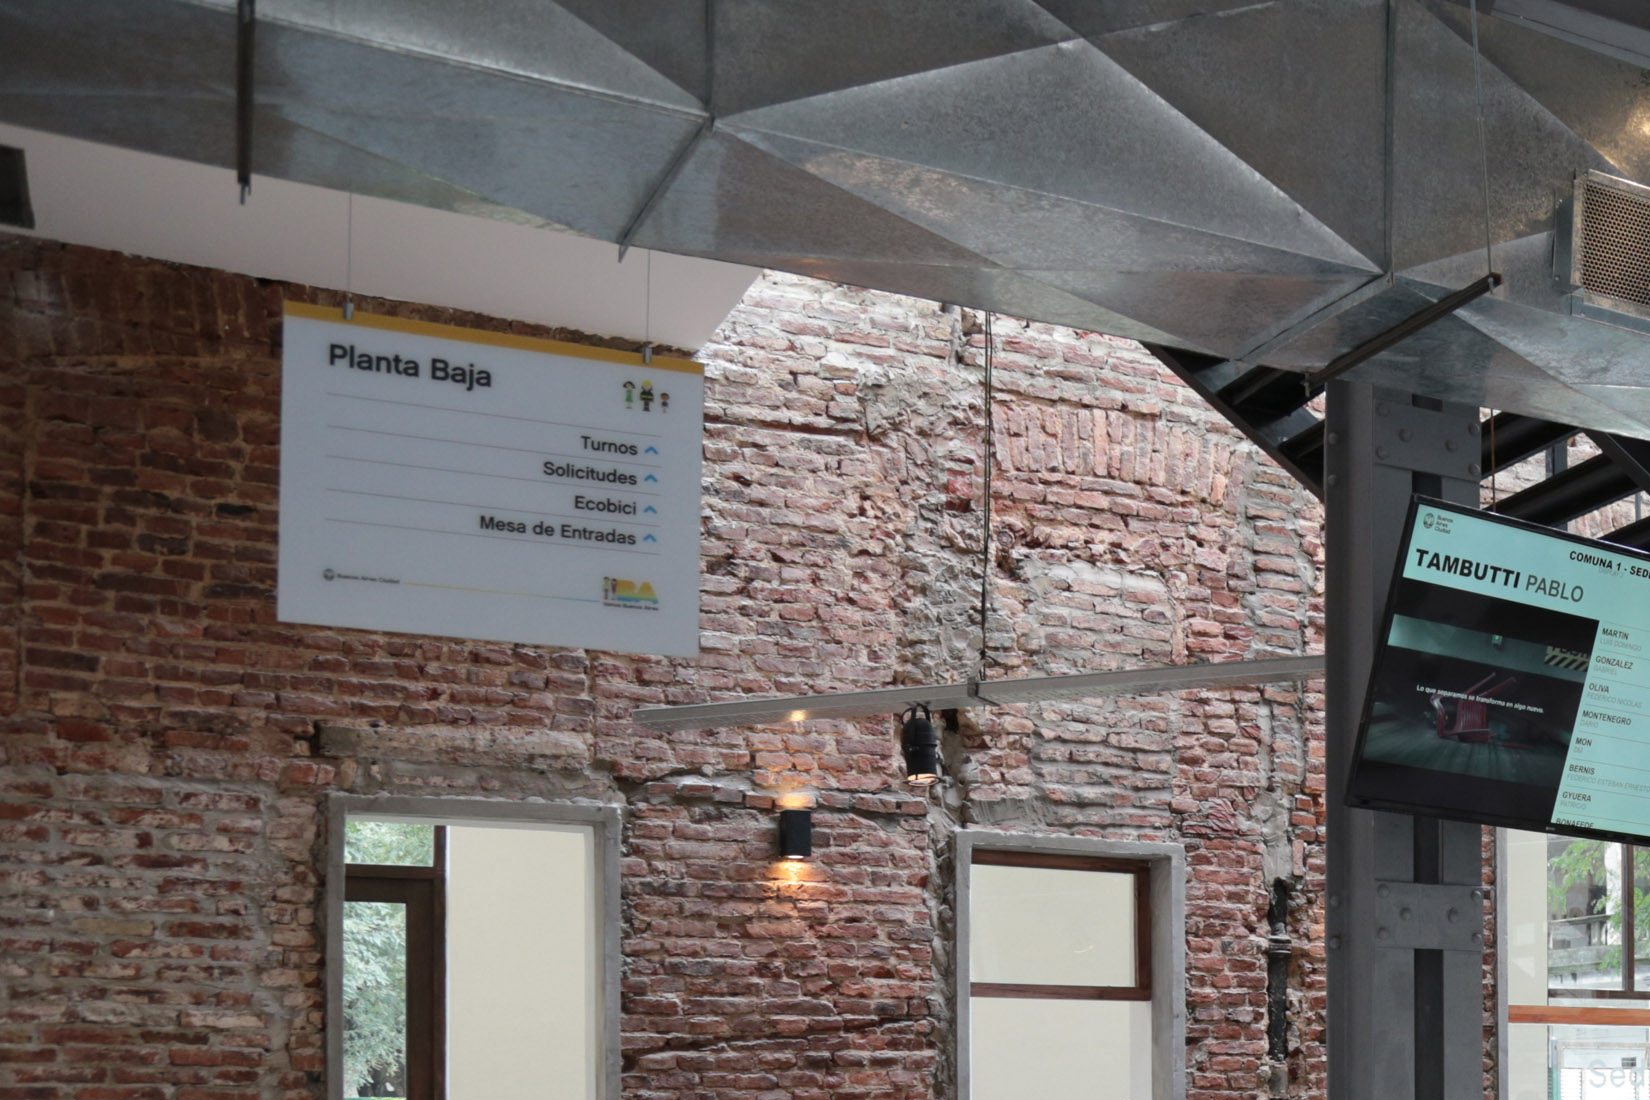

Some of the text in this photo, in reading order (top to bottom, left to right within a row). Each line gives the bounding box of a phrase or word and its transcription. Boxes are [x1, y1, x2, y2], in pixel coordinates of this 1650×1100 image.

[329, 343, 492, 391] Planta Baja
[581, 435, 638, 456] Turnos
[543, 461, 637, 485] Solicitudes
[574, 495, 637, 516] Ecobici
[479, 515, 636, 545] Mesa de Entradas
[1570, 551, 1613, 569] COMUNA
[1616, 562, 1621, 571] 1
[1415, 548, 1584, 602] TAMBUTTI PABLO
[1602, 628, 1628, 639] MARTIN
[1596, 655, 1633, 669] GONZALEZ
[1589, 682, 1609, 693] OLIVA
[1582, 710, 1631, 725] MONTENEGRO
[1575, 737, 1592, 746] MON
[1569, 764, 1595, 775] BERNIS
